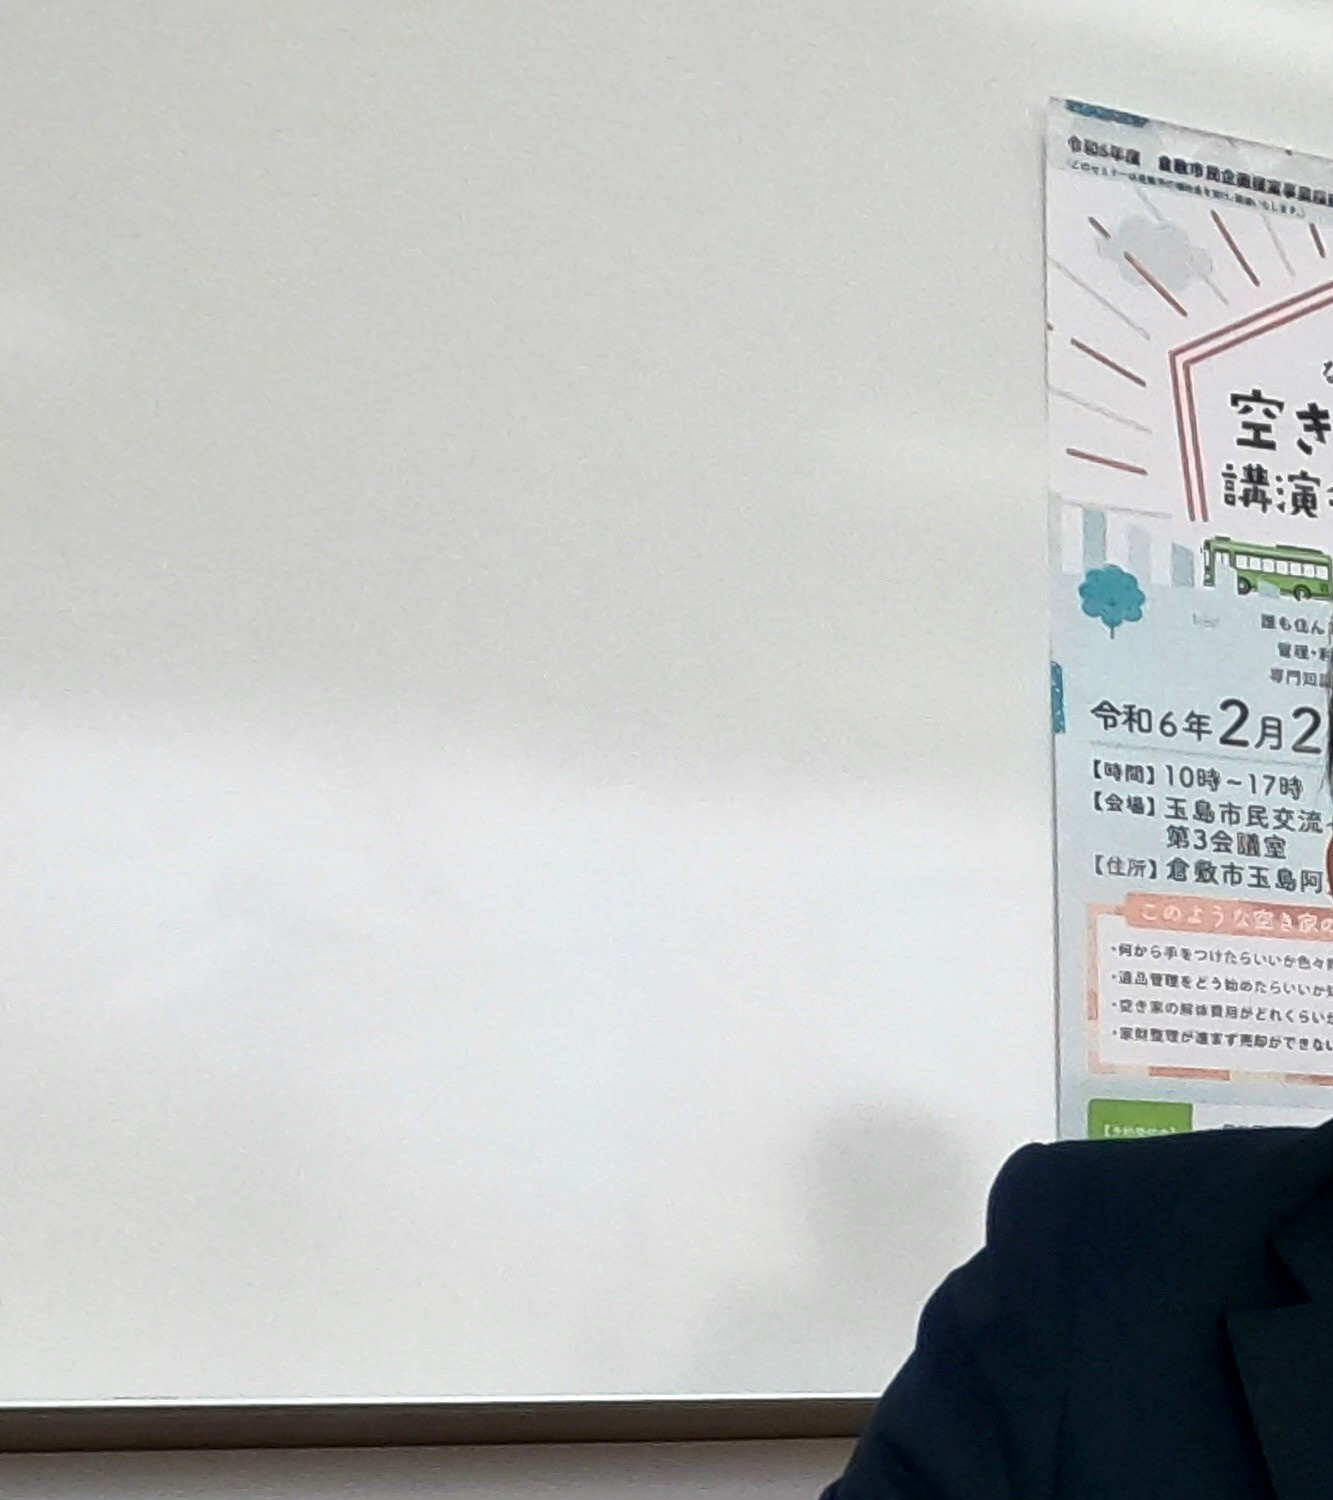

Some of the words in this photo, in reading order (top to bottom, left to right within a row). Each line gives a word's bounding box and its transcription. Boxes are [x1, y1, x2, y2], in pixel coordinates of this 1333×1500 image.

[1090, 698, 1322, 754] 令和6年2月2
[1166, 823, 1288, 861] 第3会議室
[1093, 854, 1331, 894] 【住所】倉敷市玉島阿
